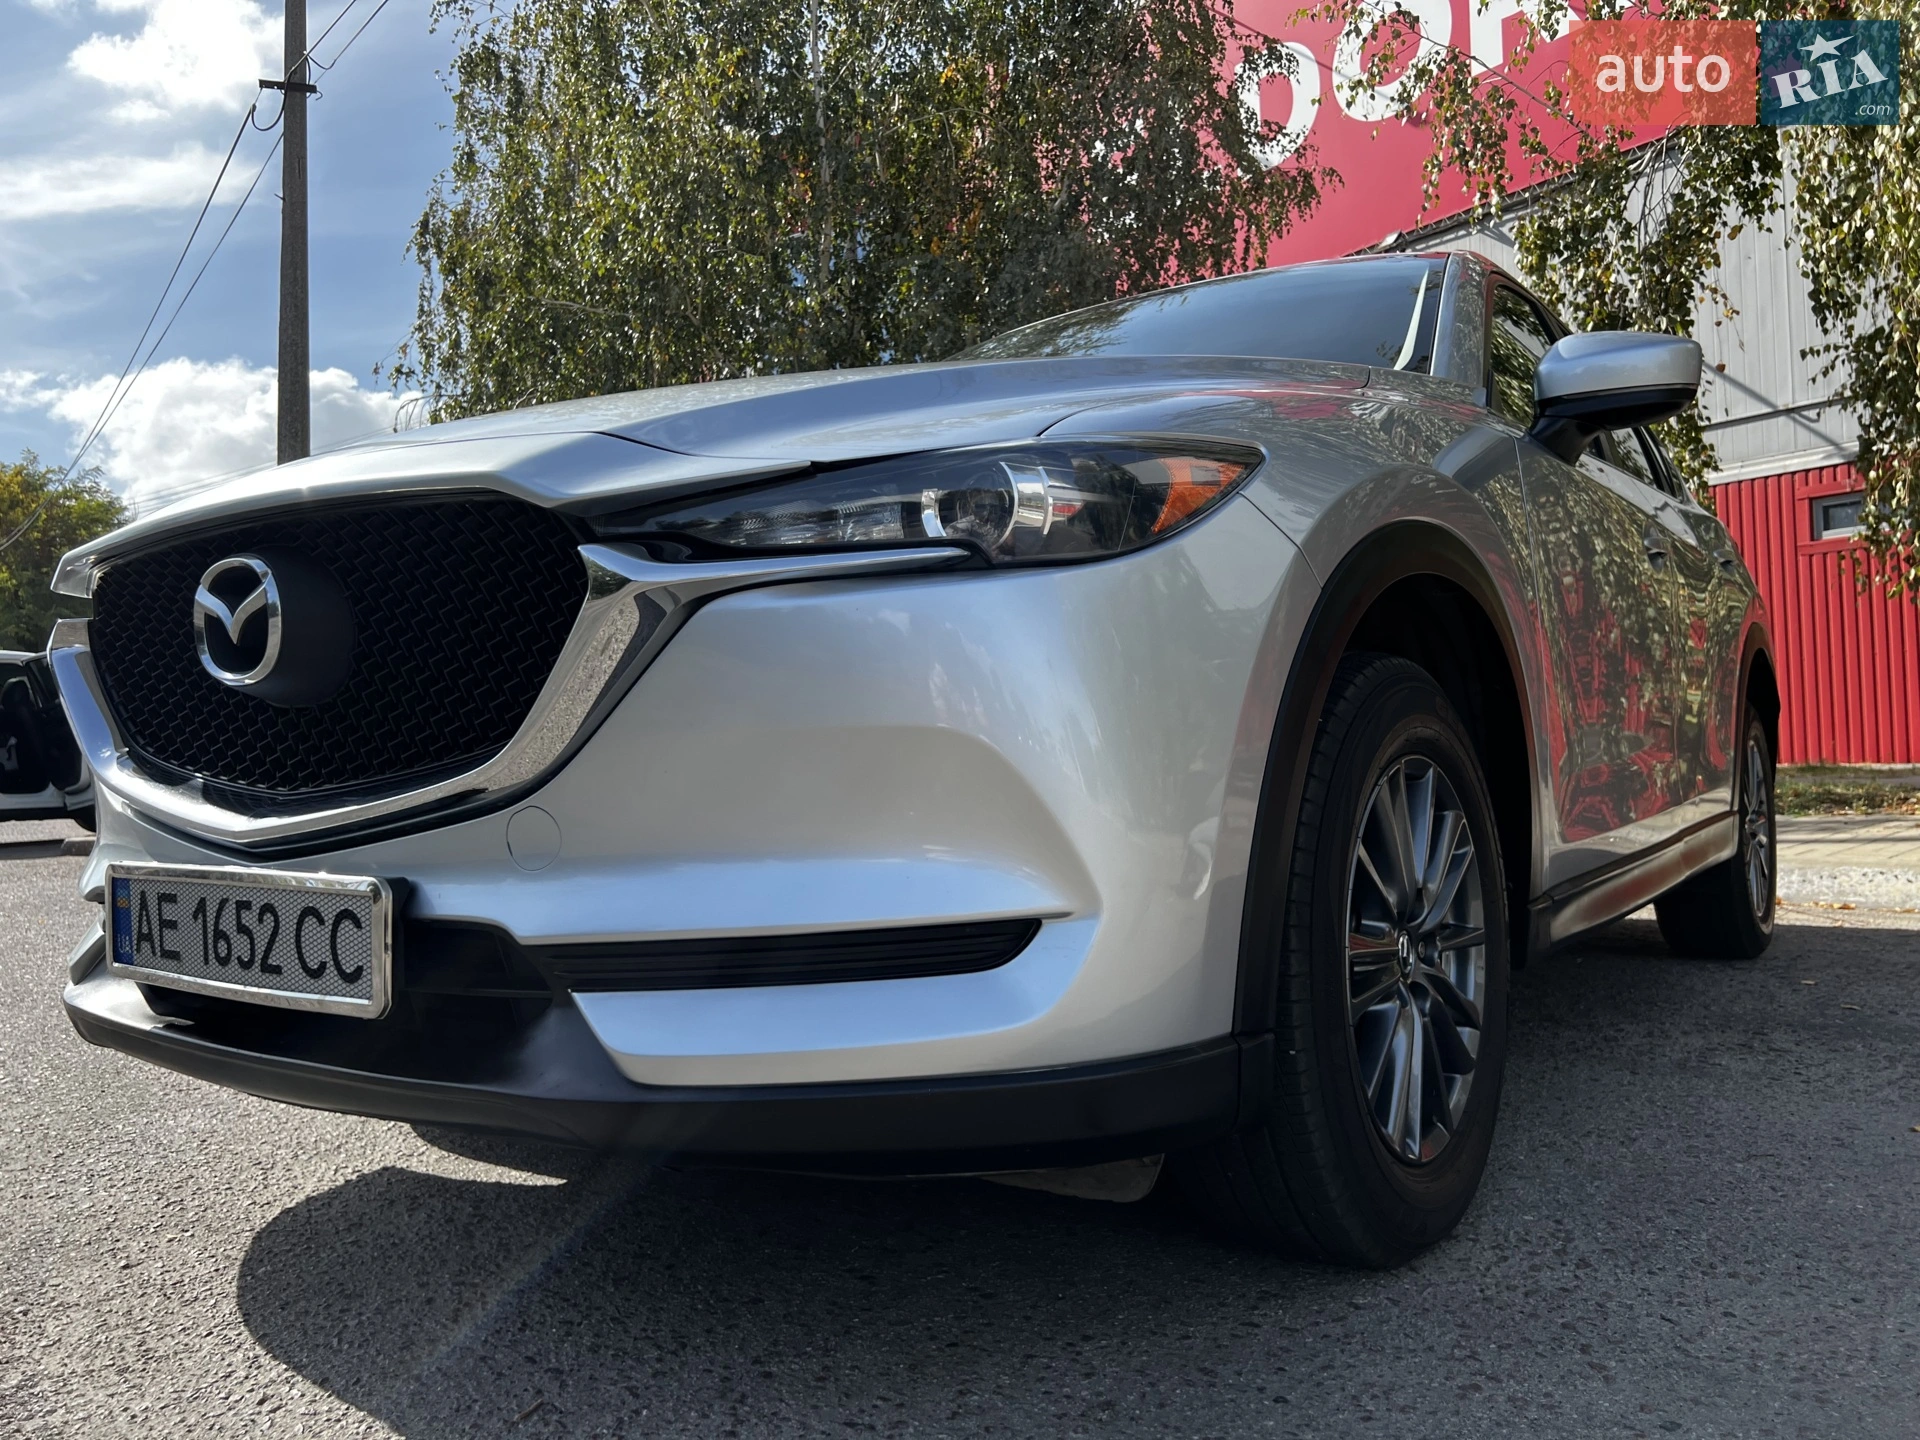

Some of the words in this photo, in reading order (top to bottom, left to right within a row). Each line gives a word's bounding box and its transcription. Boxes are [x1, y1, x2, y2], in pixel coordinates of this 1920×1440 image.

[135, 890, 181, 961] AE
[192, 896, 283, 975] 1652
[295, 905, 364, 984] CC
